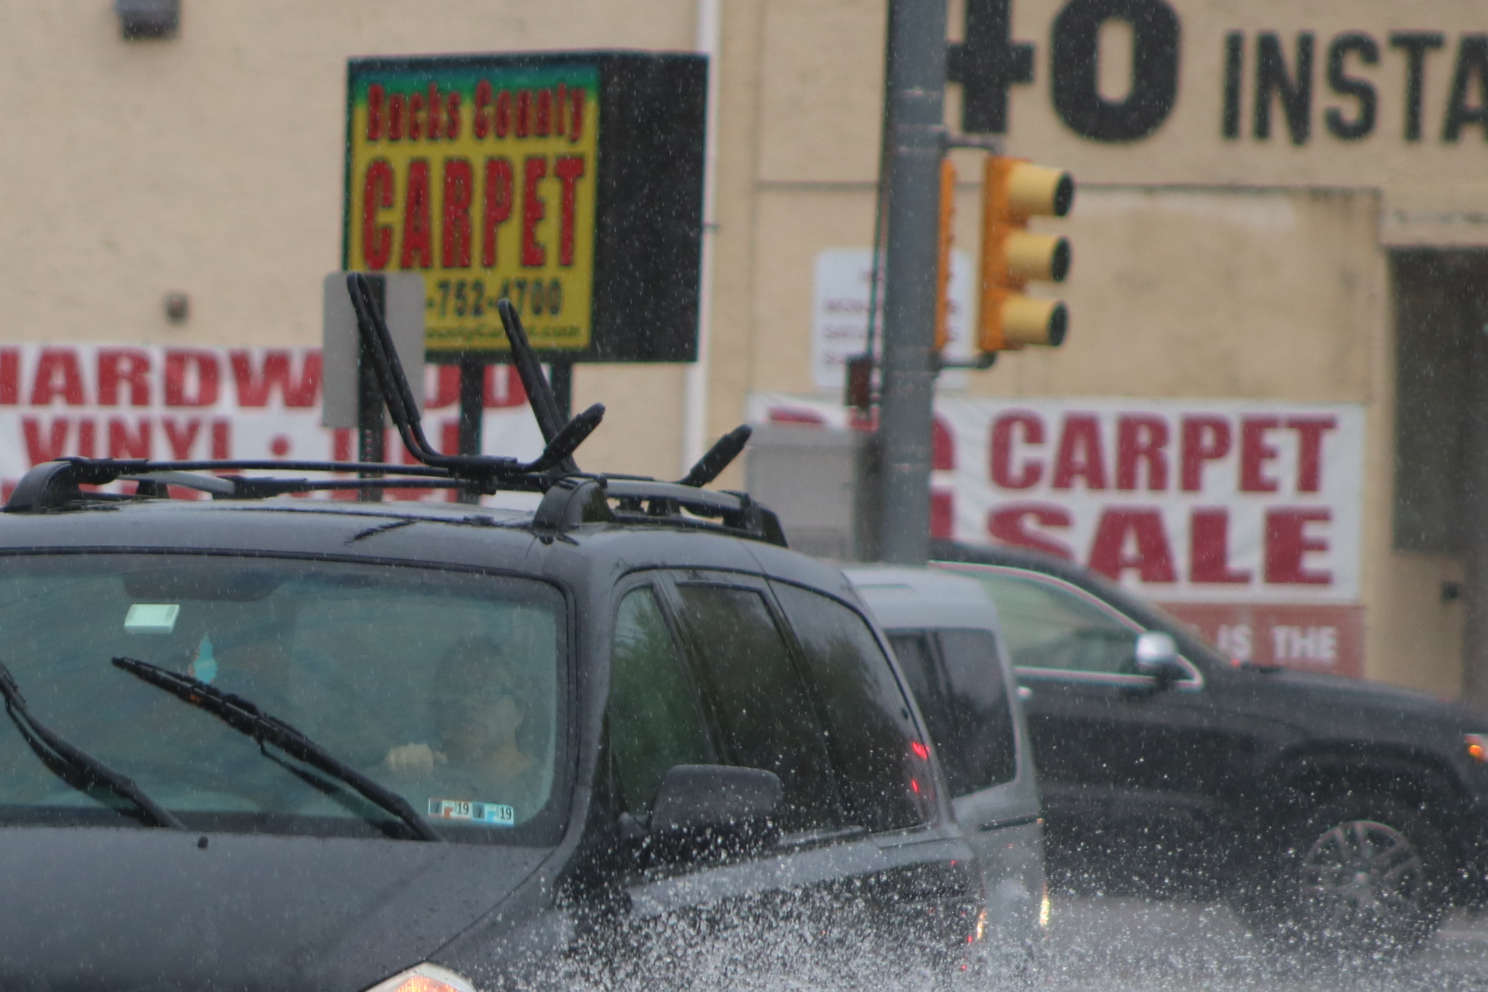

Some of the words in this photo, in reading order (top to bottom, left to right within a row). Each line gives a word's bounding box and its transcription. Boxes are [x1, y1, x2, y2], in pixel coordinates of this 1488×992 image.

[364, 156, 585, 270] CARPET
[989, 411, 1338, 492] CARPET
[986, 503, 1334, 587] SALE
[1272, 625, 1338, 662] THE
[457, 802, 469, 815] 19
[500, 806, 512, 820] 19
